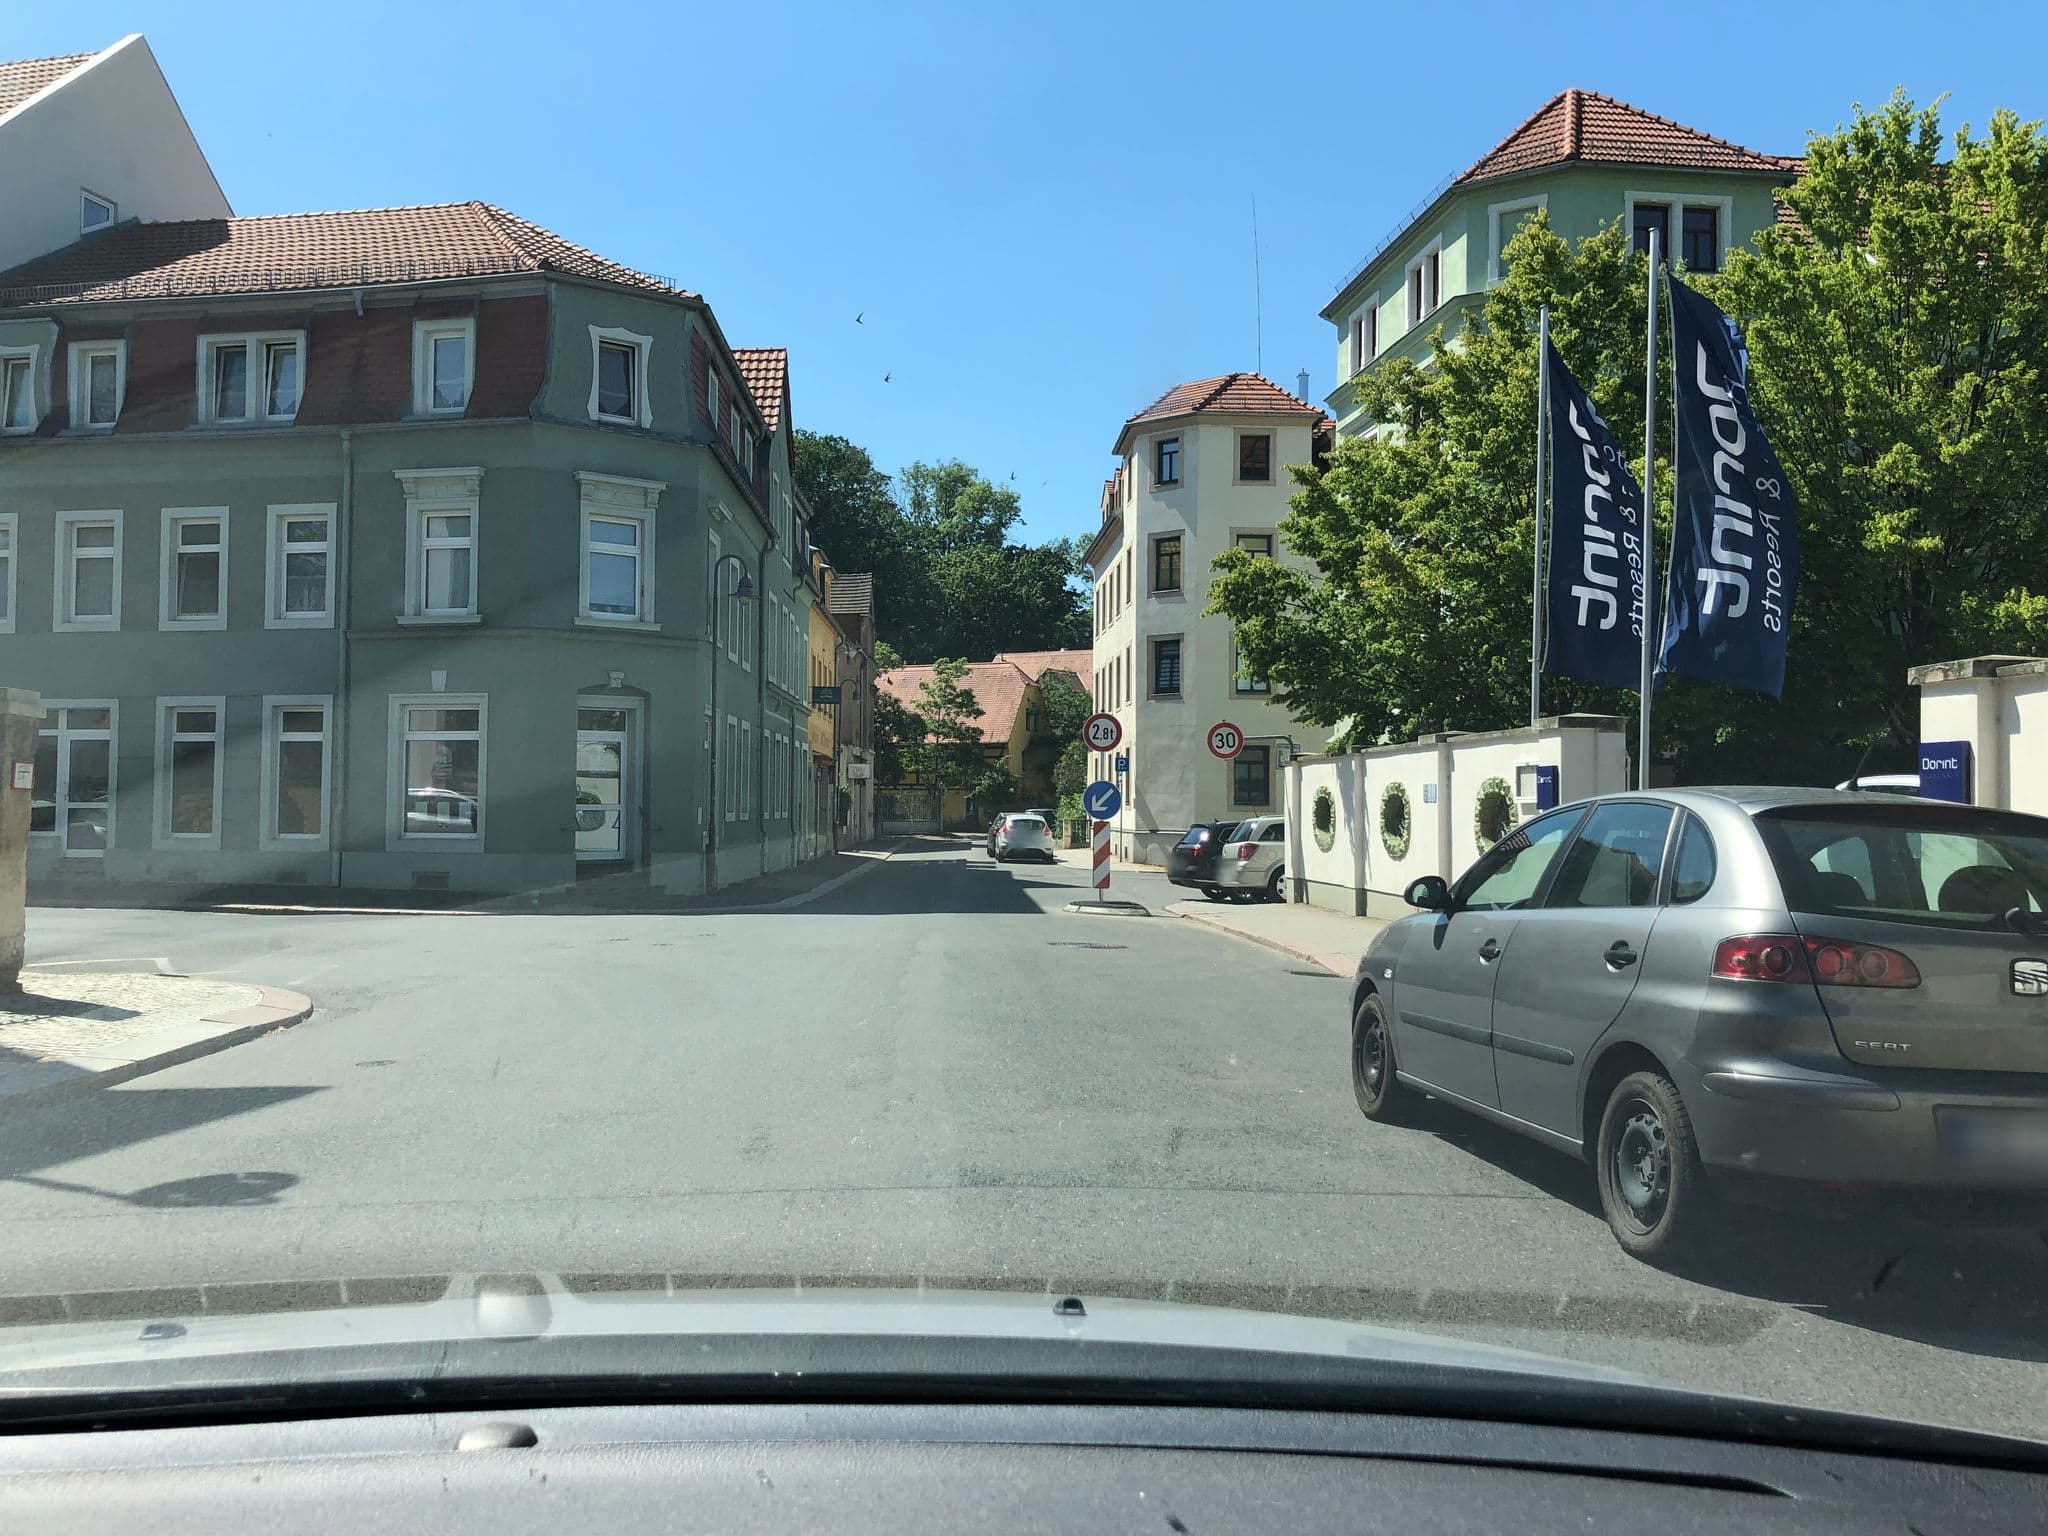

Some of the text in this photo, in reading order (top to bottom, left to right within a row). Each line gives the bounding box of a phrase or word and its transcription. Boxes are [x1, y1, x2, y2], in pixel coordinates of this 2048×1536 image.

[1214, 732, 1236, 749] 30
[1117, 759, 1126, 770] P
[1922, 757, 1958, 770] Dorint
[1854, 1040, 1912, 1051] SEAT
